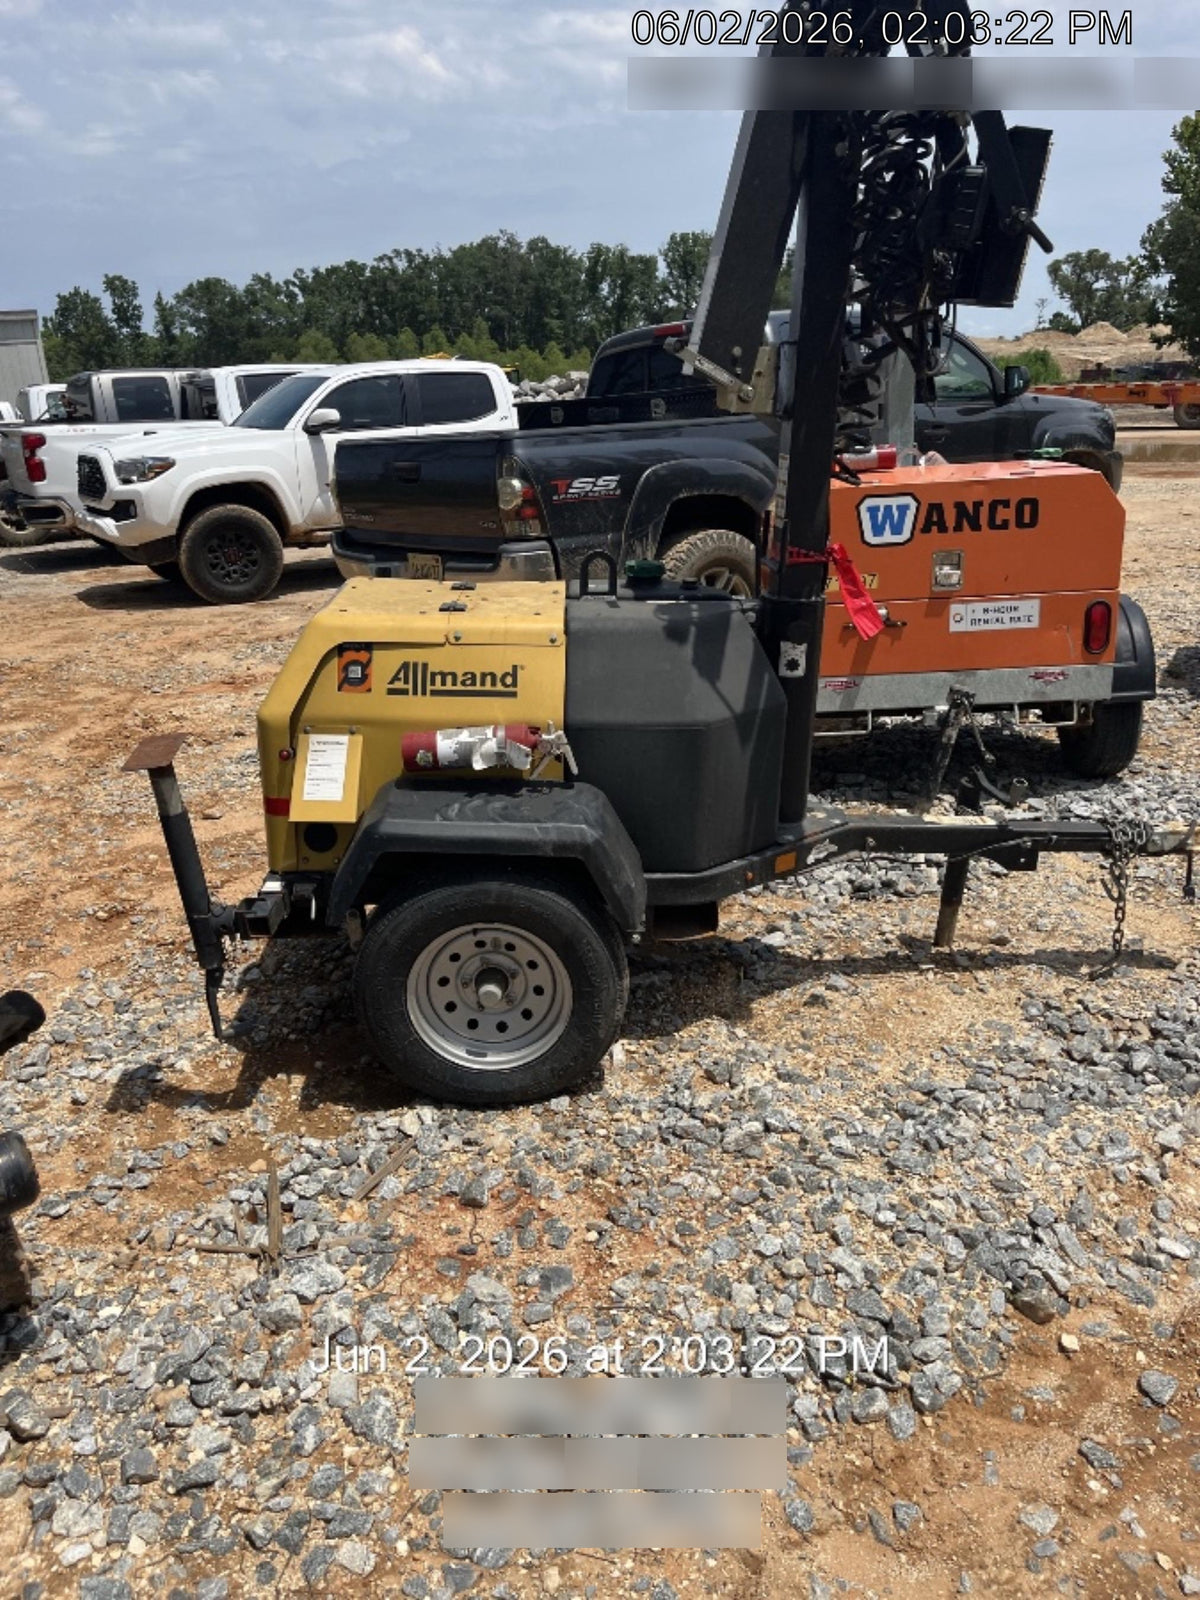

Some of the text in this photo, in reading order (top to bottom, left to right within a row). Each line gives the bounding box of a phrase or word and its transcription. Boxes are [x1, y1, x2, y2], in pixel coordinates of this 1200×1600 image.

[550, 474, 621, 495] TSS
[866, 497, 1040, 538] WANCO
[387, 661, 518, 697] Allmand
